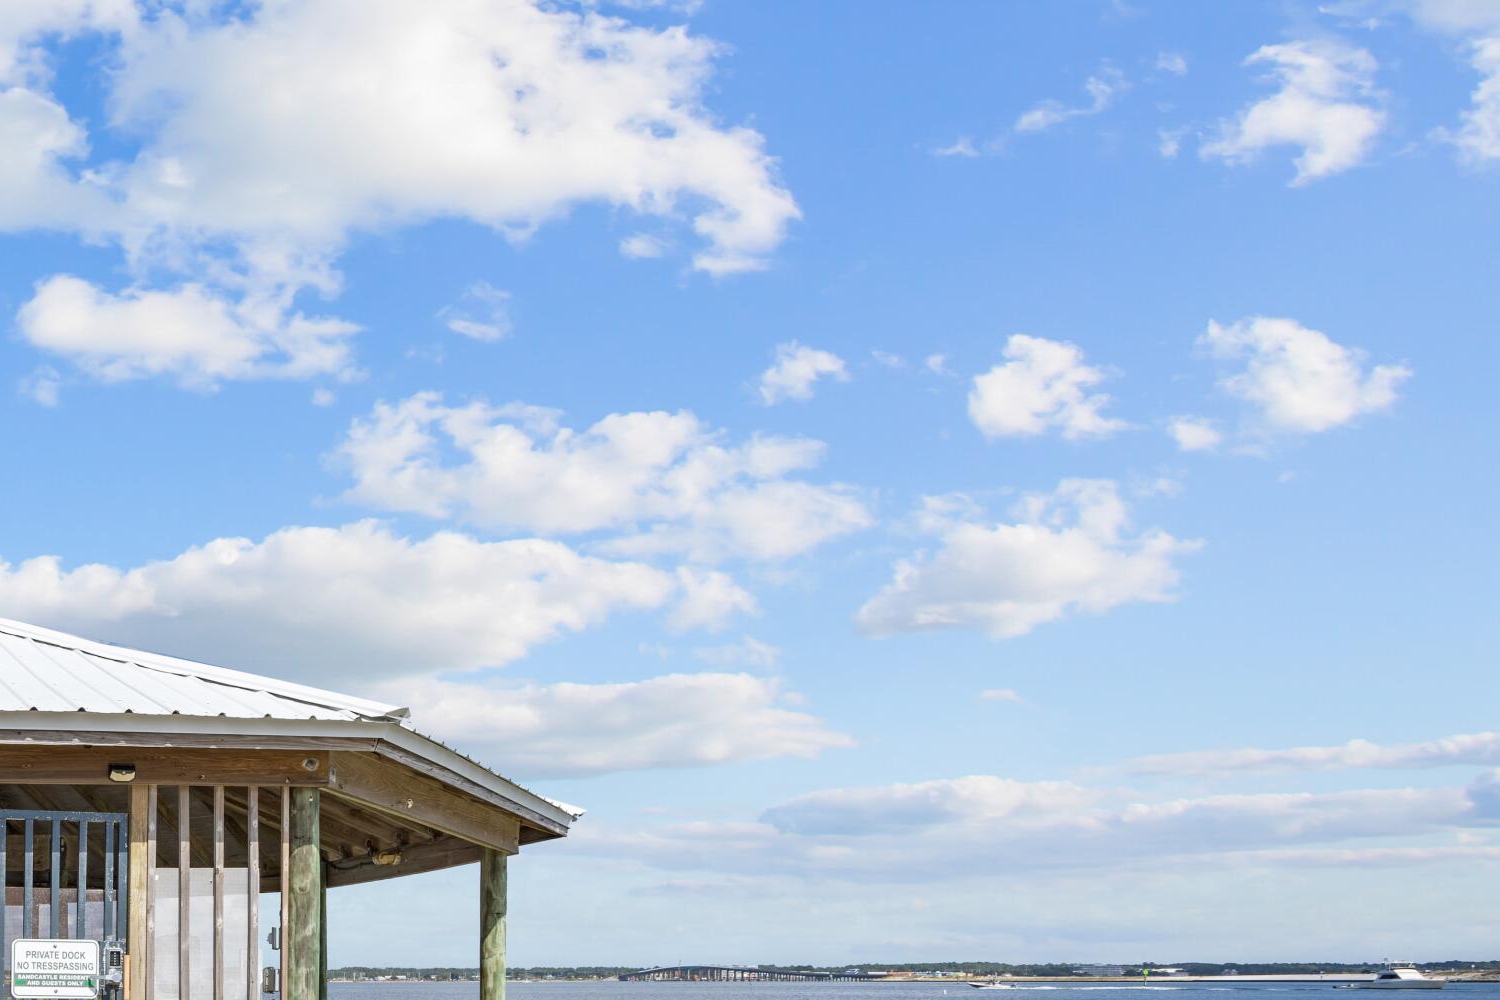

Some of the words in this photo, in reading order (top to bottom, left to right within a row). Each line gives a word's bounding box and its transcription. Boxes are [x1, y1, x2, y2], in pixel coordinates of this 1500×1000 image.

[25, 950, 59, 959] PRIVATE
[62, 951, 86, 960] DOCK
[17, 961, 29, 970] NO
[32, 962, 94, 971] TRESSPASSING
